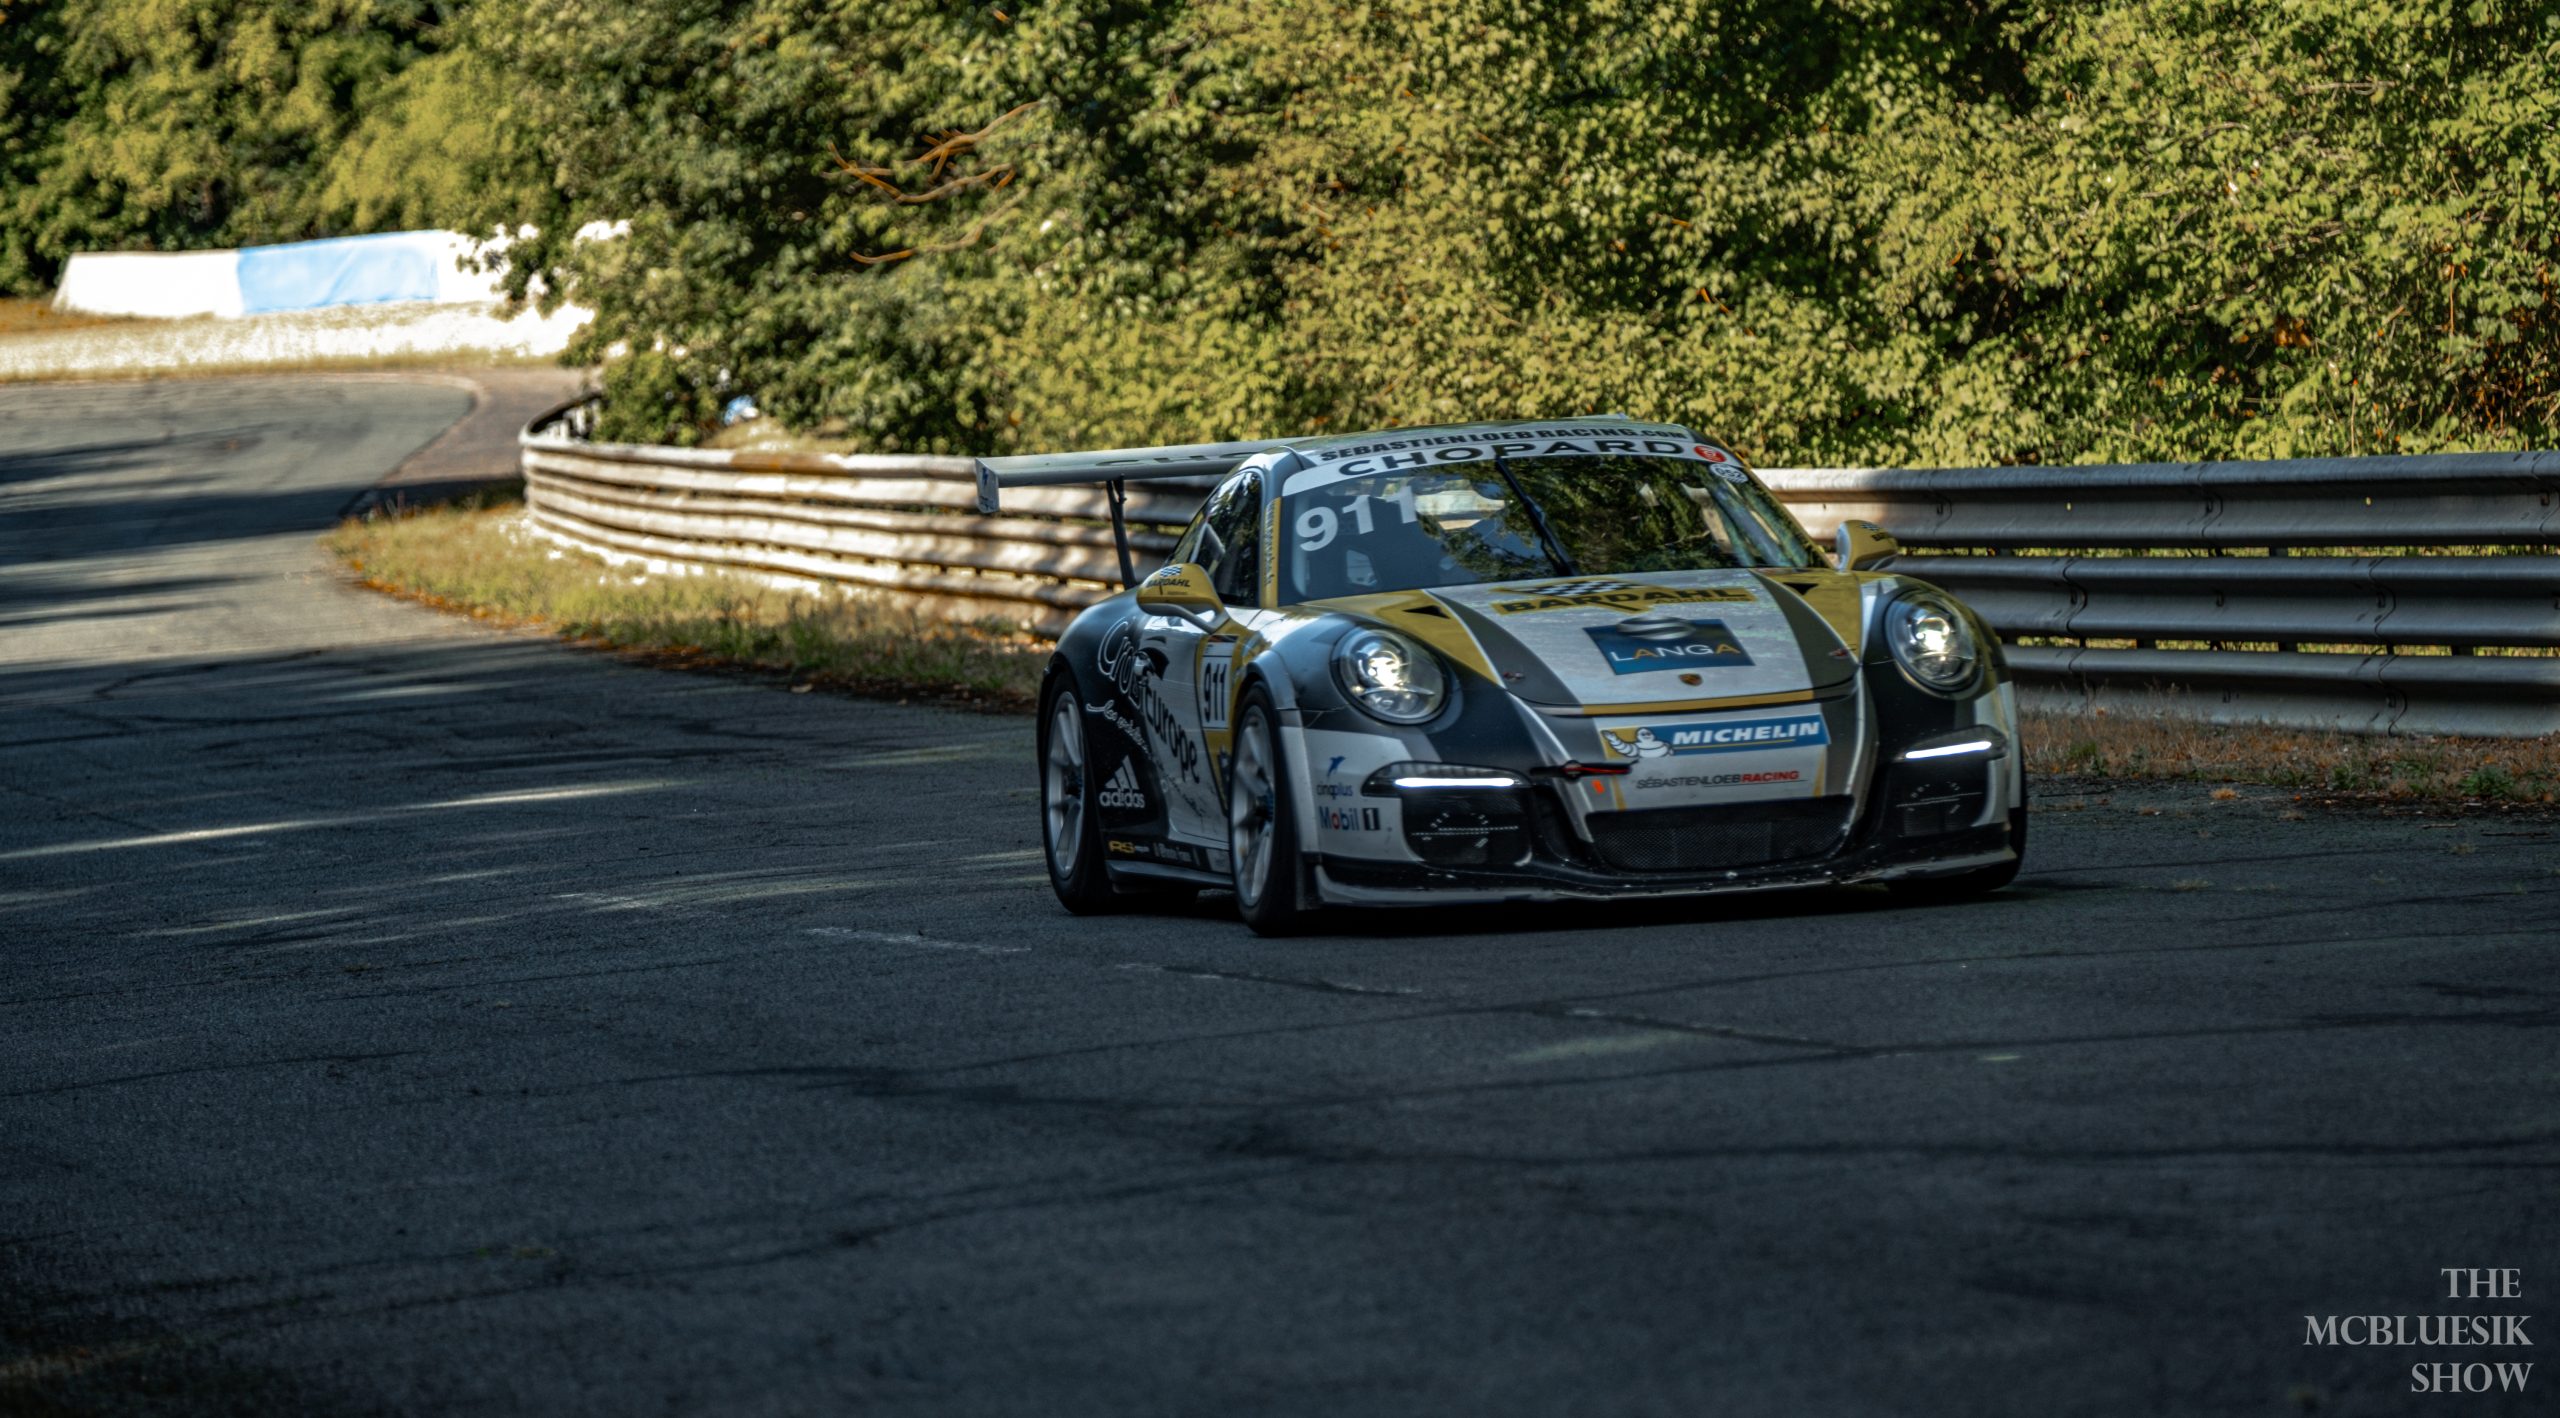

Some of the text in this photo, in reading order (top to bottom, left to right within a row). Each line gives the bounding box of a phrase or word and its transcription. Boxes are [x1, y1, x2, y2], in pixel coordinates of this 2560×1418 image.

[1338, 440, 1684, 476] CHOPARD
[1295, 485, 1418, 552] 911
[1500, 588, 1748, 612] BARDAHL
[1609, 643, 1741, 662] LANGA
[1203, 662, 1228, 723] 911
[1673, 721, 1820, 745] MICHELIN
[1099, 789, 1146, 809] adidas
[1319, 806, 1360, 831] Mobil
